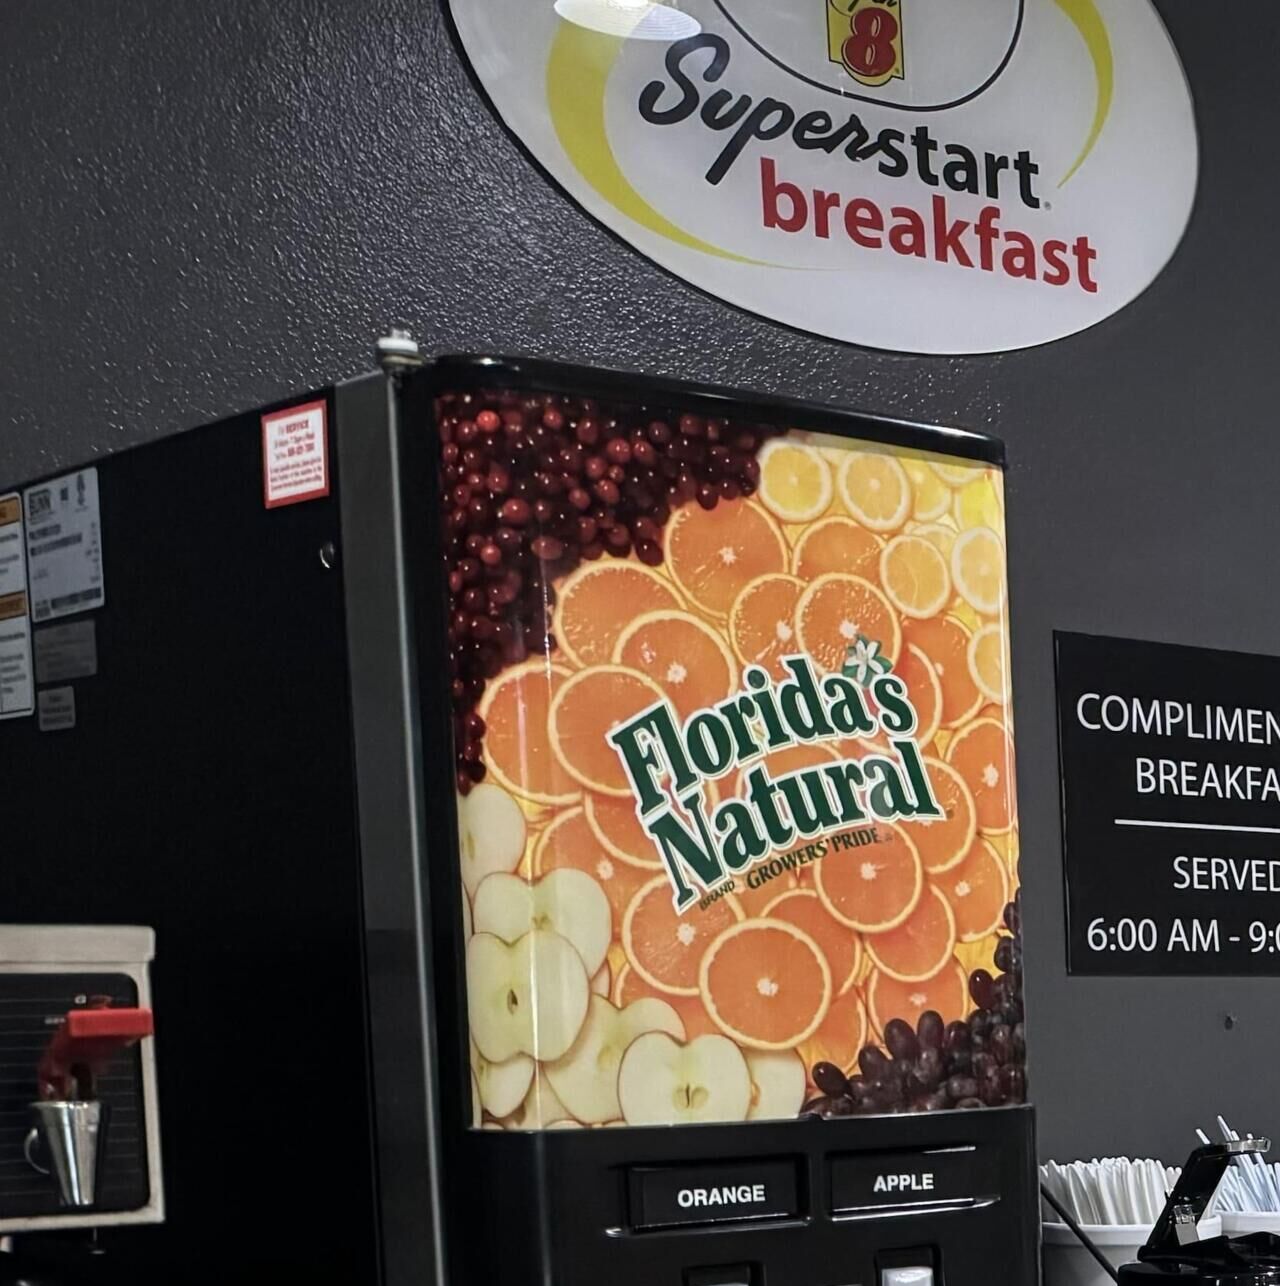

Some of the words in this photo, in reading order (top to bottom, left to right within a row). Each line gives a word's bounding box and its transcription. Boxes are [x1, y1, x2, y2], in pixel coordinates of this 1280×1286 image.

[840, 7, 898, 78] 8
[638, 32, 1041, 209] Superstart
[760, 156, 1098, 292] breakfast
[647, 740, 942, 909] Natural
[831, 828, 879, 852] PRIDE
[1087, 917, 1157, 951] 6:00
[1167, 918, 1220, 952] AM
[677, 1184, 765, 1208] ORANGE
[873, 1173, 934, 1193] APPLE
